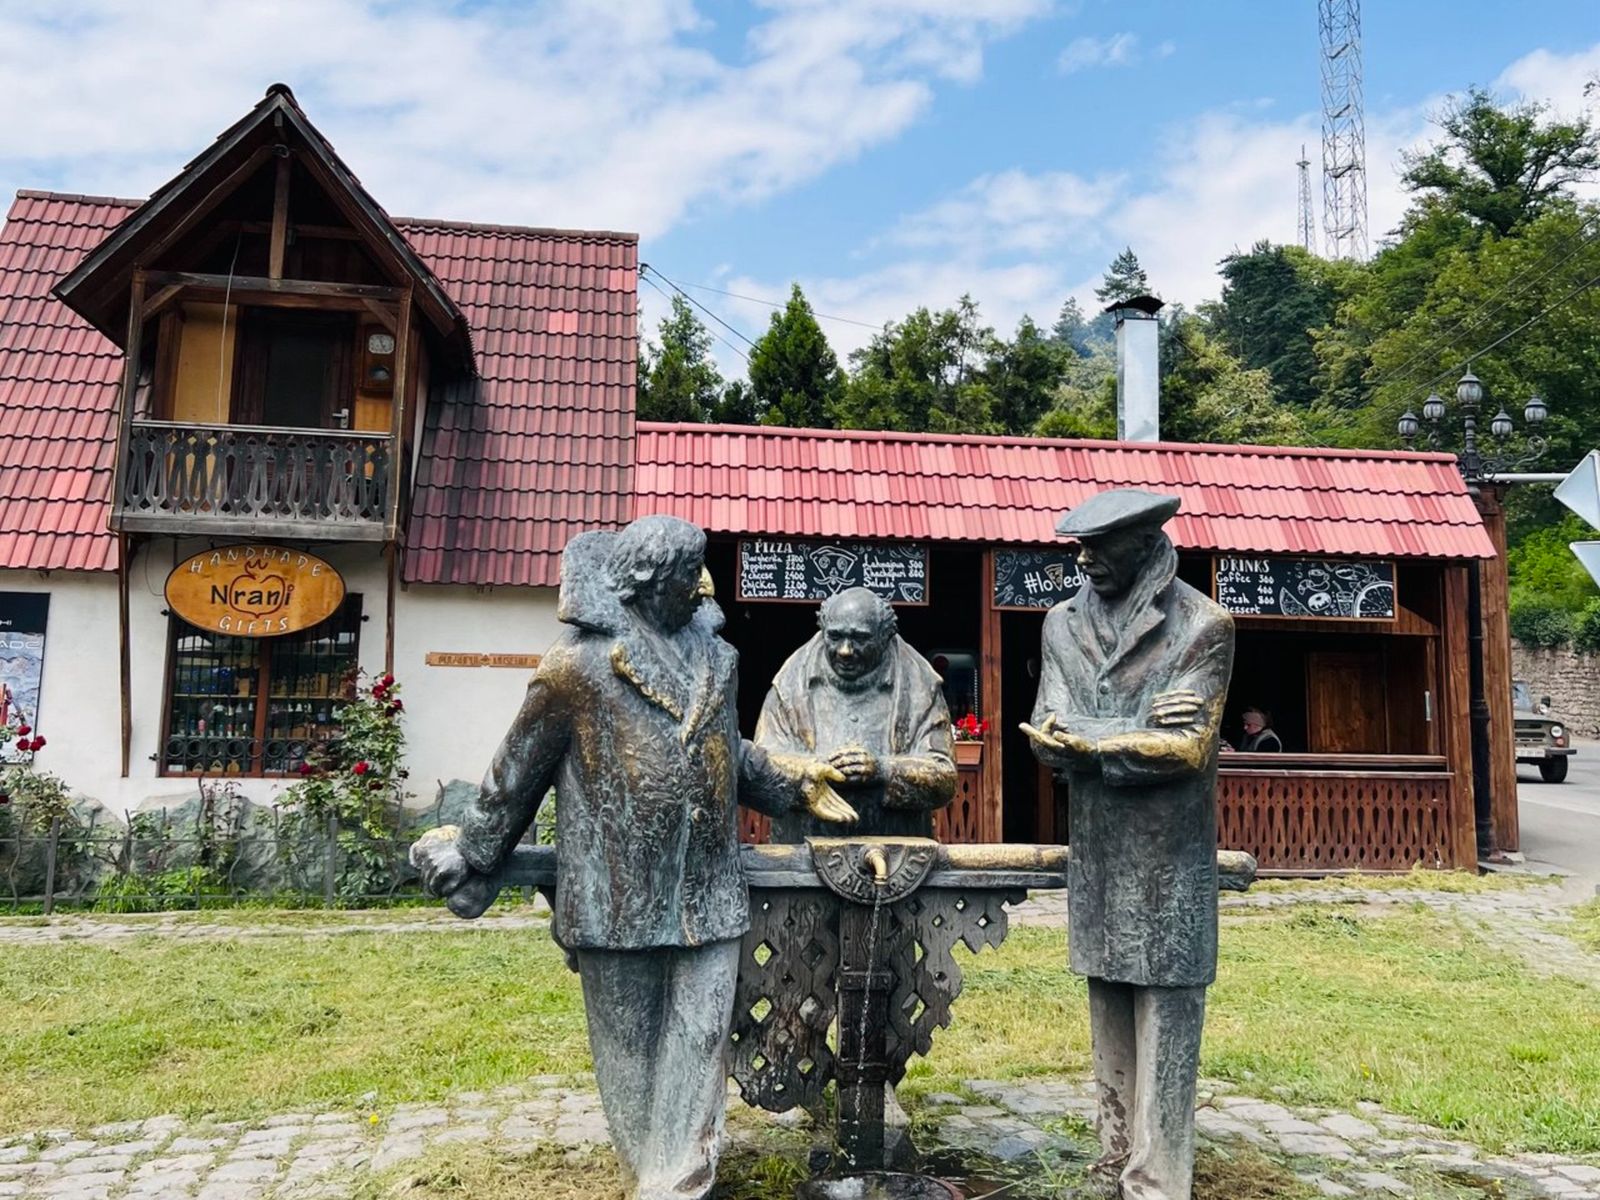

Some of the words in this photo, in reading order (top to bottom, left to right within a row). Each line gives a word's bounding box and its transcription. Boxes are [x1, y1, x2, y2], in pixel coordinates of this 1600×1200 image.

[754, 541, 793, 554] PIZZA
[190, 547, 322, 577] HANDMADE
[1220, 559, 1270, 573] DRINKS
[1215, 571, 1251, 583] Coffee
[211, 584, 295, 606] Nrani
[1216, 583, 1236, 594] Tea
[1219, 592, 1250, 605] Fresh
[219, 616, 290, 632] GIFTS
